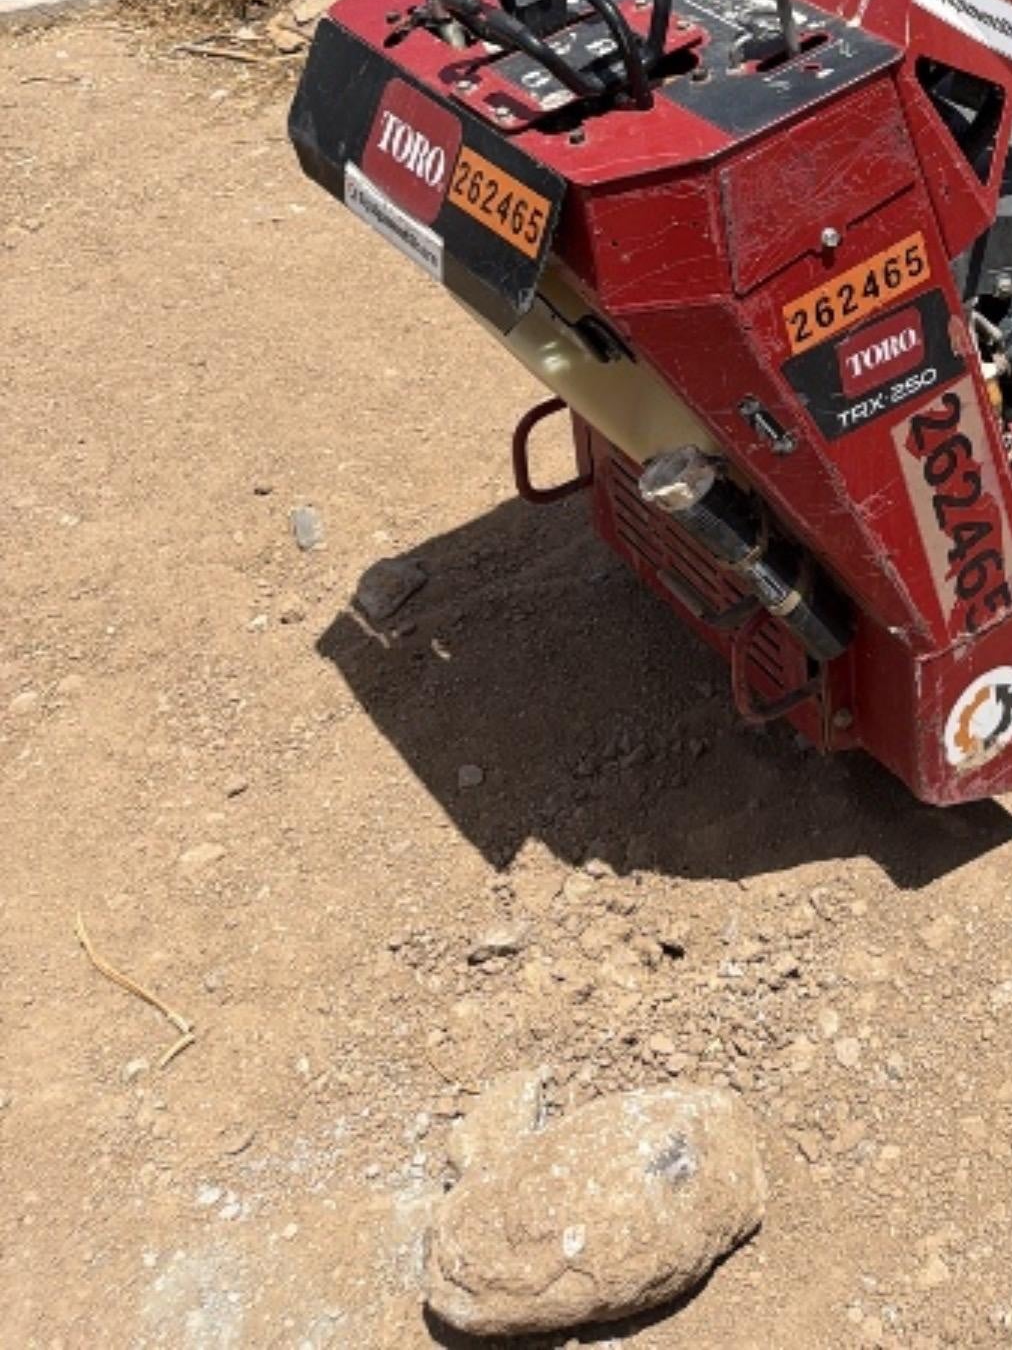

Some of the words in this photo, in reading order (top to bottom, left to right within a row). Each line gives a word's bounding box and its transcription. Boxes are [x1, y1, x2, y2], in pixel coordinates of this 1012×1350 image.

[376, 110, 445, 187] TORO
[453, 161, 544, 244] 262465
[788, 245, 924, 343] 262465
[844, 327, 918, 378] TORO
